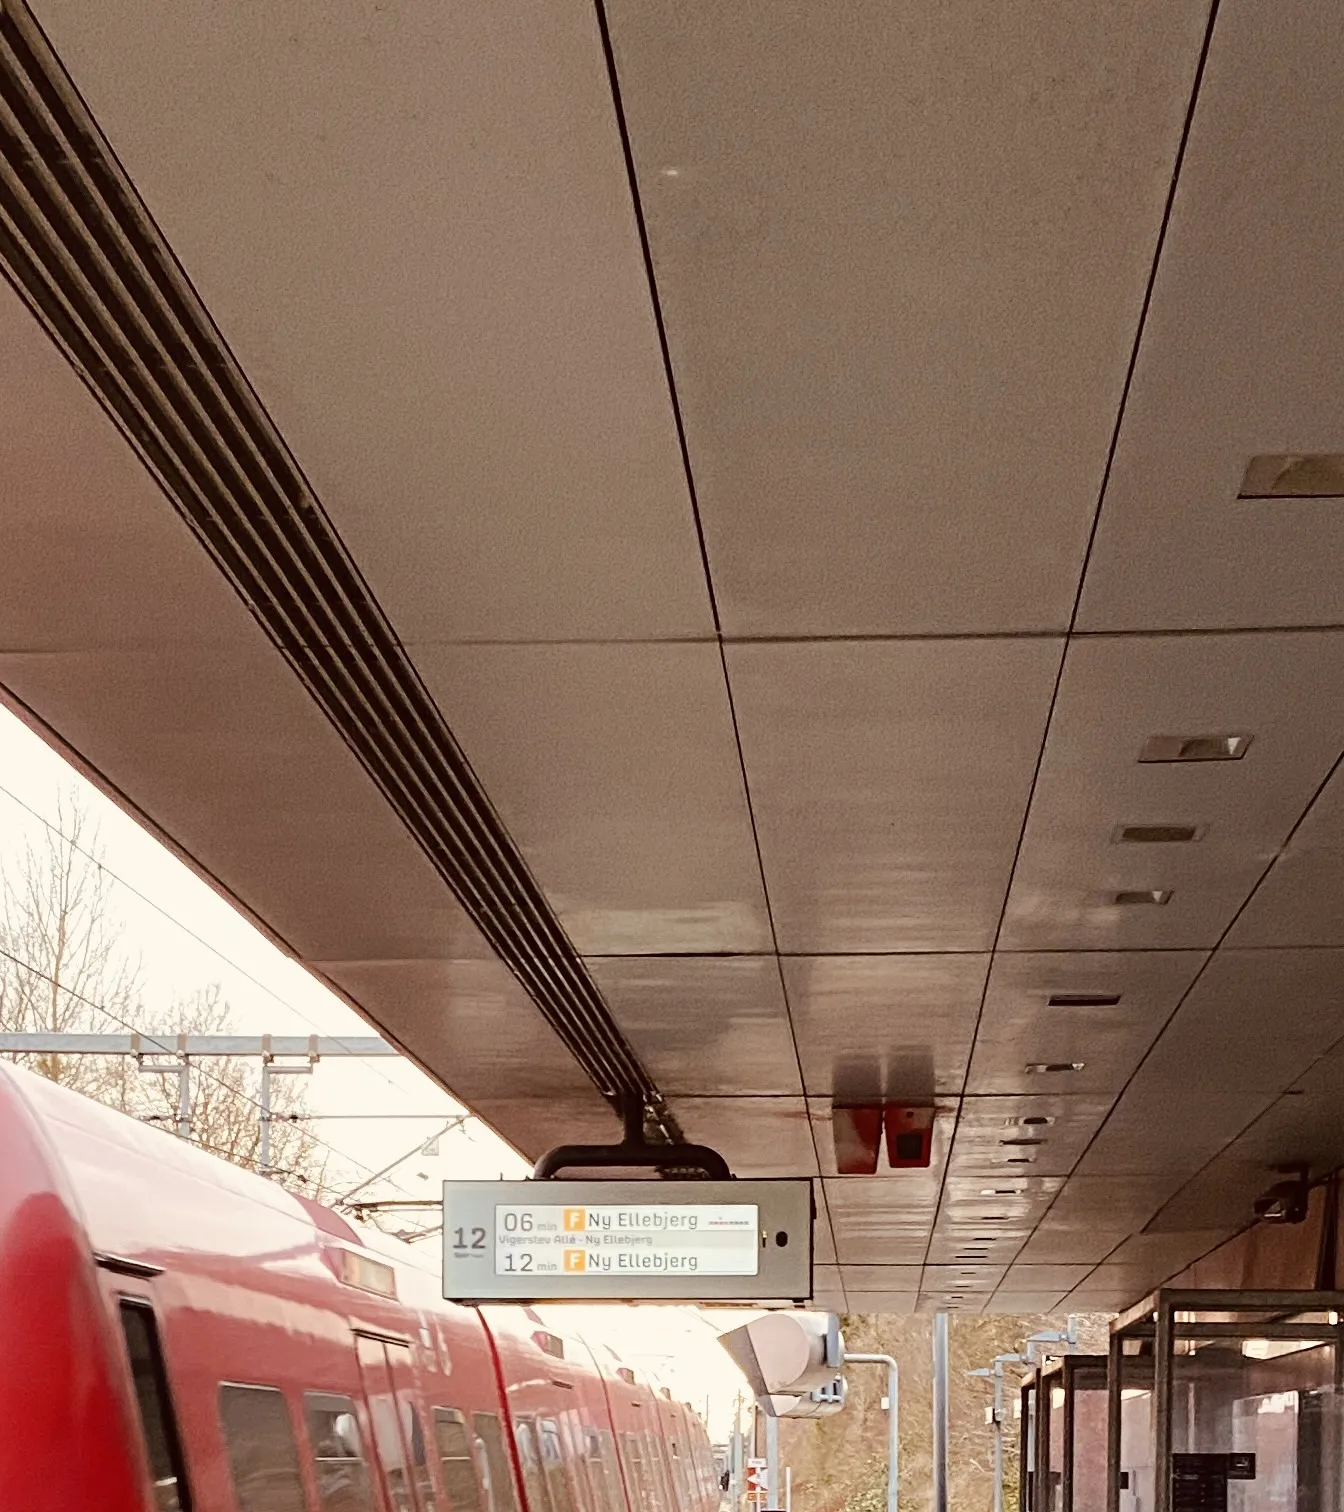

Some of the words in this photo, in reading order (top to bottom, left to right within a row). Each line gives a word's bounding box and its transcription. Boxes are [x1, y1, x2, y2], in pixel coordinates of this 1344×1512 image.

[504, 1212, 534, 1232] 06
[537, 1220, 558, 1231] min
[588, 1212, 612, 1231] Ny
[618, 1211, 699, 1231] Ellebjerg
[453, 1227, 487, 1249] 12
[586, 1235, 601, 1246] Ny
[603, 1234, 654, 1247] Ellebjerg
[504, 1252, 534, 1272] 12
[537, 1261, 558, 1271] min
[588, 1253, 612, 1272] Ny
[618, 1252, 699, 1271] Ellebjerg
